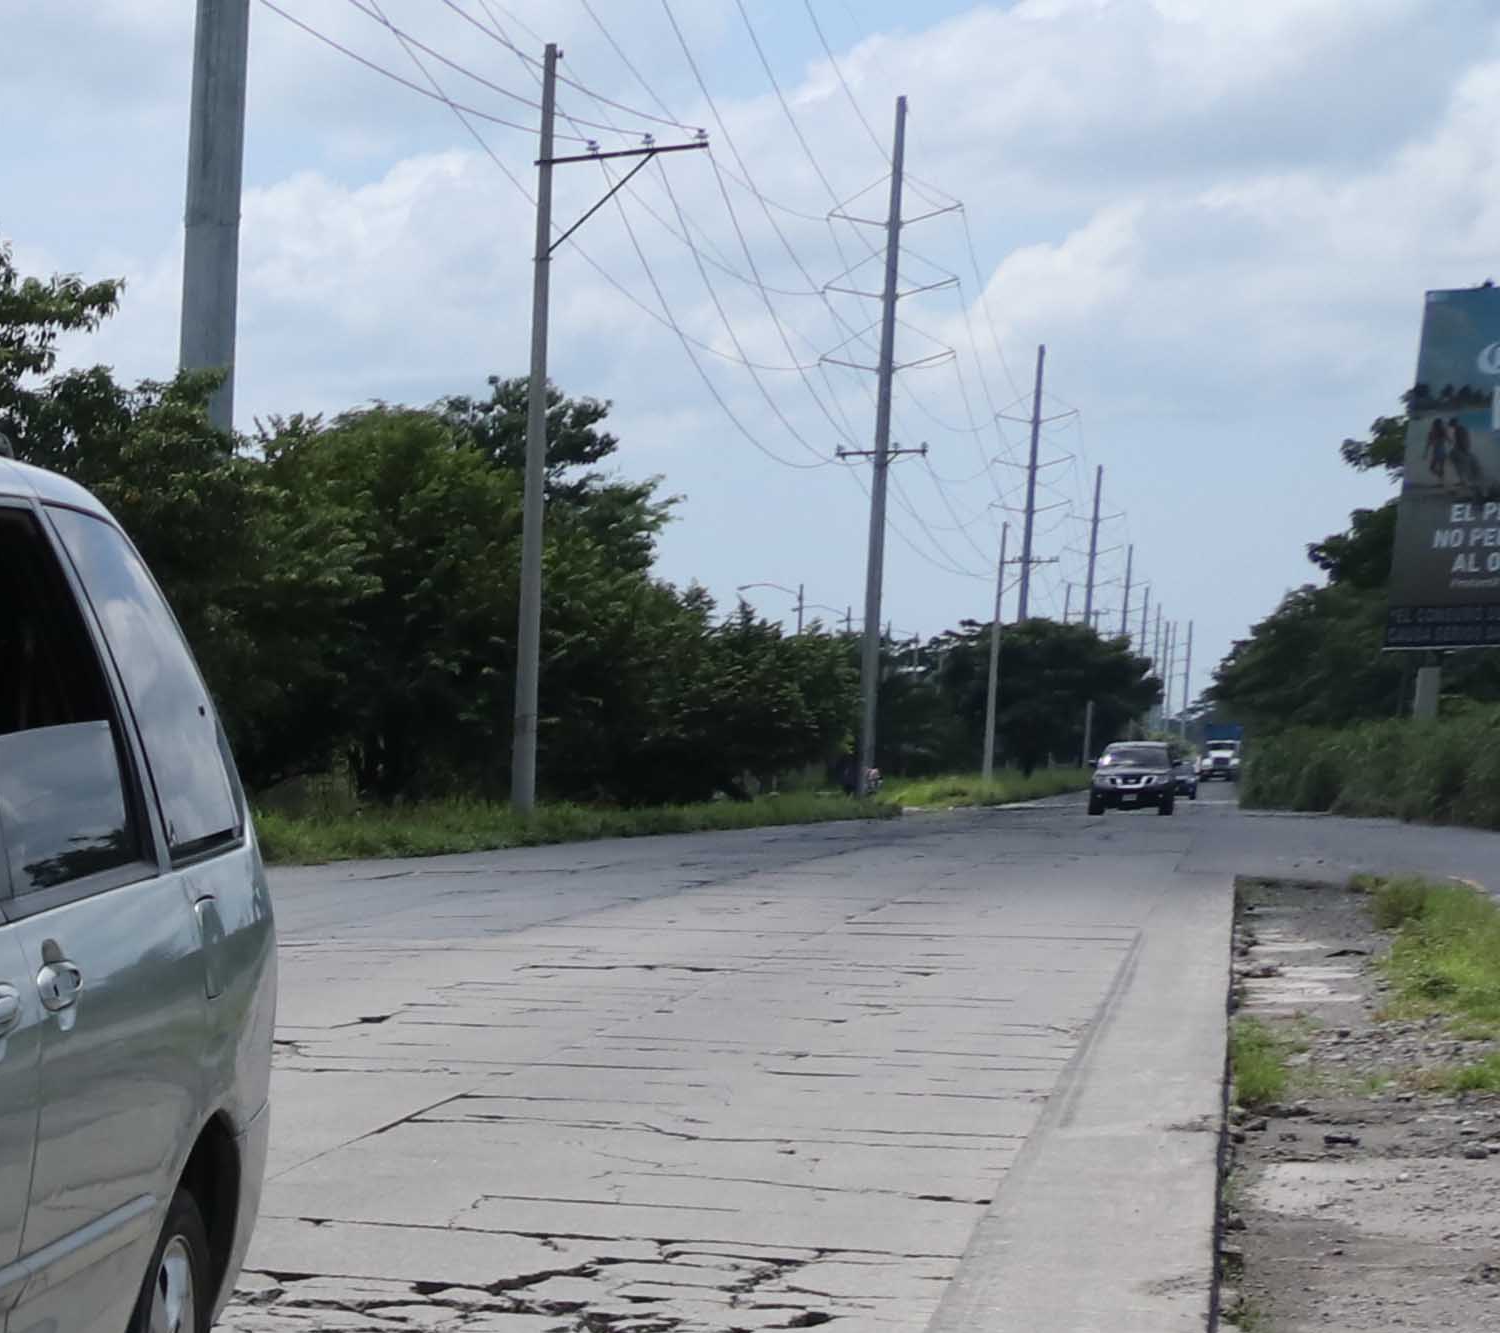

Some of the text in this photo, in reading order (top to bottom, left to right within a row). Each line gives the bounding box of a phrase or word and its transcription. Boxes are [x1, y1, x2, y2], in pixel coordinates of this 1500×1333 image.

[1450, 503, 1476, 522] EL
[1432, 529, 1464, 549] NO
[1451, 553, 1479, 573] AL
